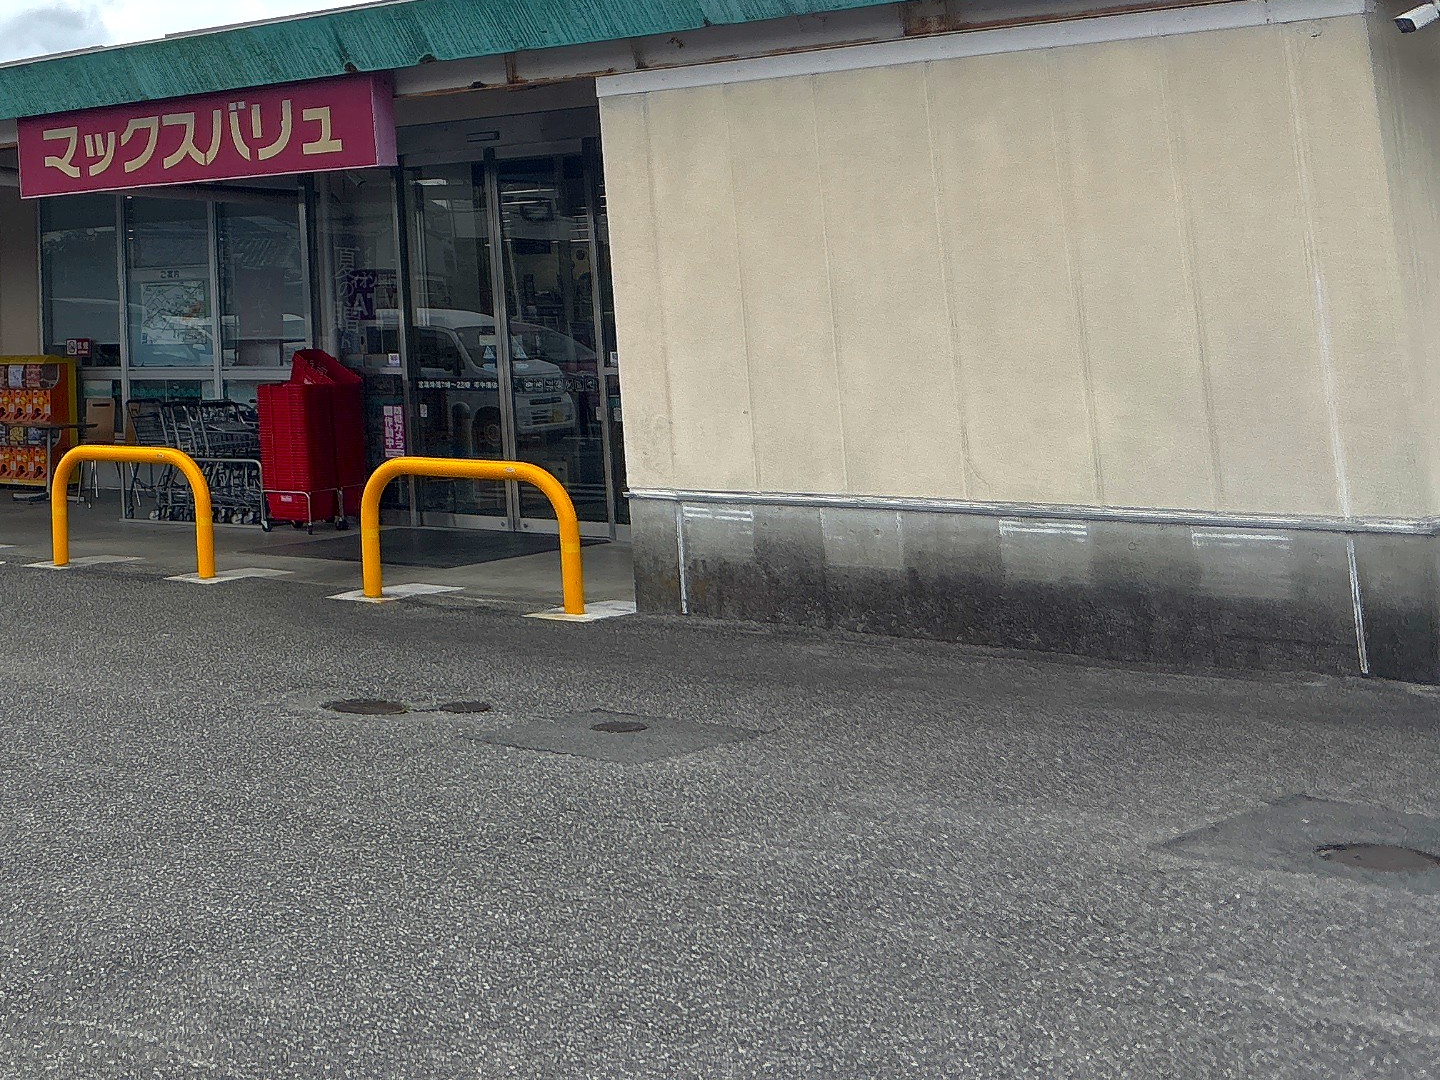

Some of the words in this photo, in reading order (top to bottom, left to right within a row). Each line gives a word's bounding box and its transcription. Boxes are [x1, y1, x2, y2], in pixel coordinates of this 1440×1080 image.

[43, 99, 343, 178] マックスバリュ
